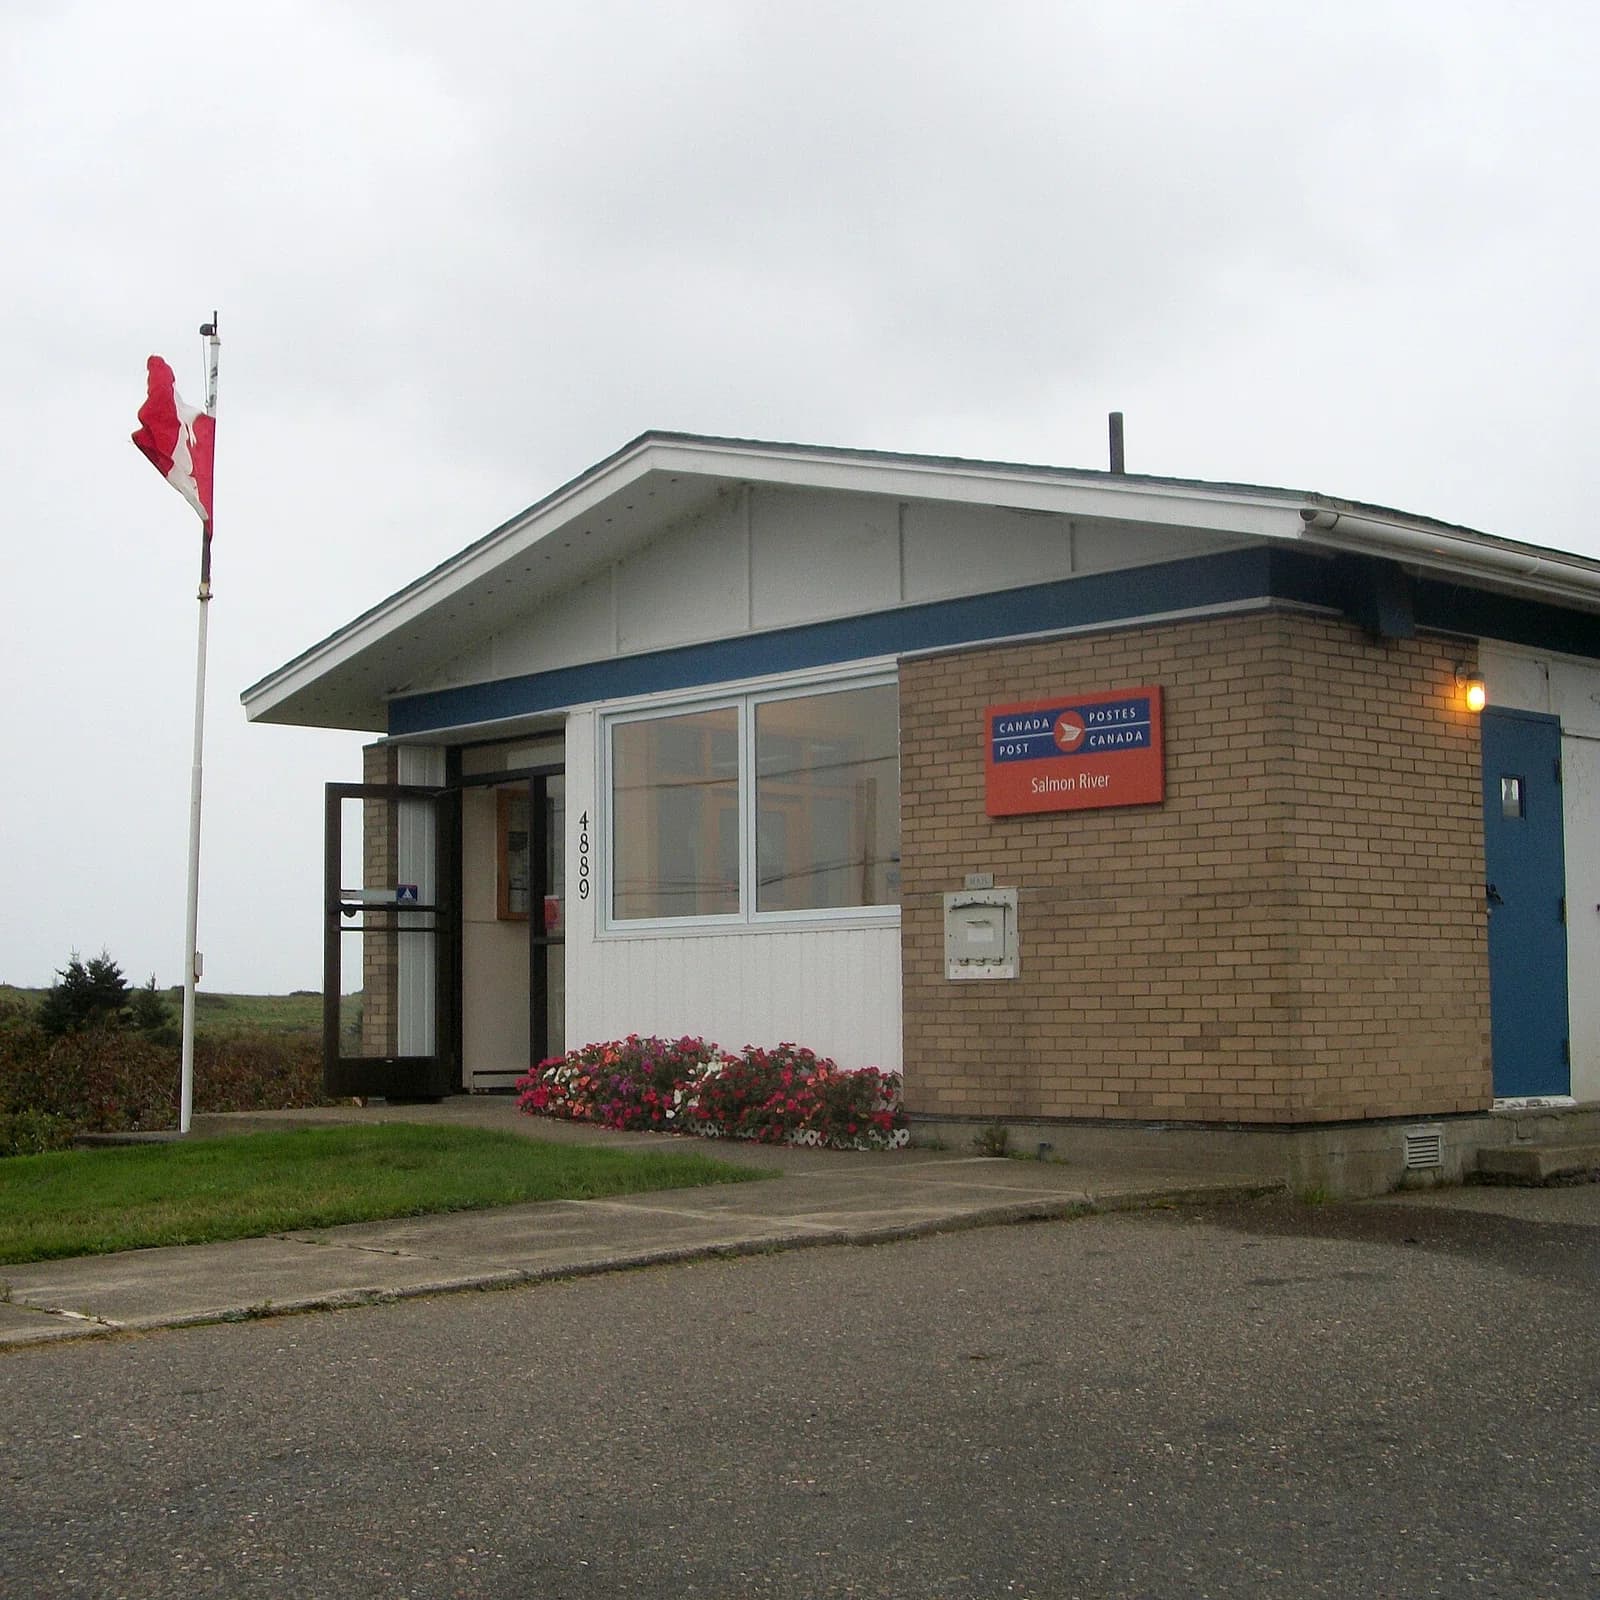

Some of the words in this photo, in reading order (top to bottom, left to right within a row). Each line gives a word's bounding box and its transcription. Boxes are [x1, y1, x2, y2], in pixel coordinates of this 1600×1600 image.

[1089, 707, 1136, 722] POSTES
[999, 718, 1050, 733] CANADA
[1089, 730, 1143, 746] CANADA
[999, 743, 1029, 756] POST
[1031, 776, 1075, 793] Salmon
[1079, 772, 1110, 788] River
[579, 810, 589, 900] 4889
